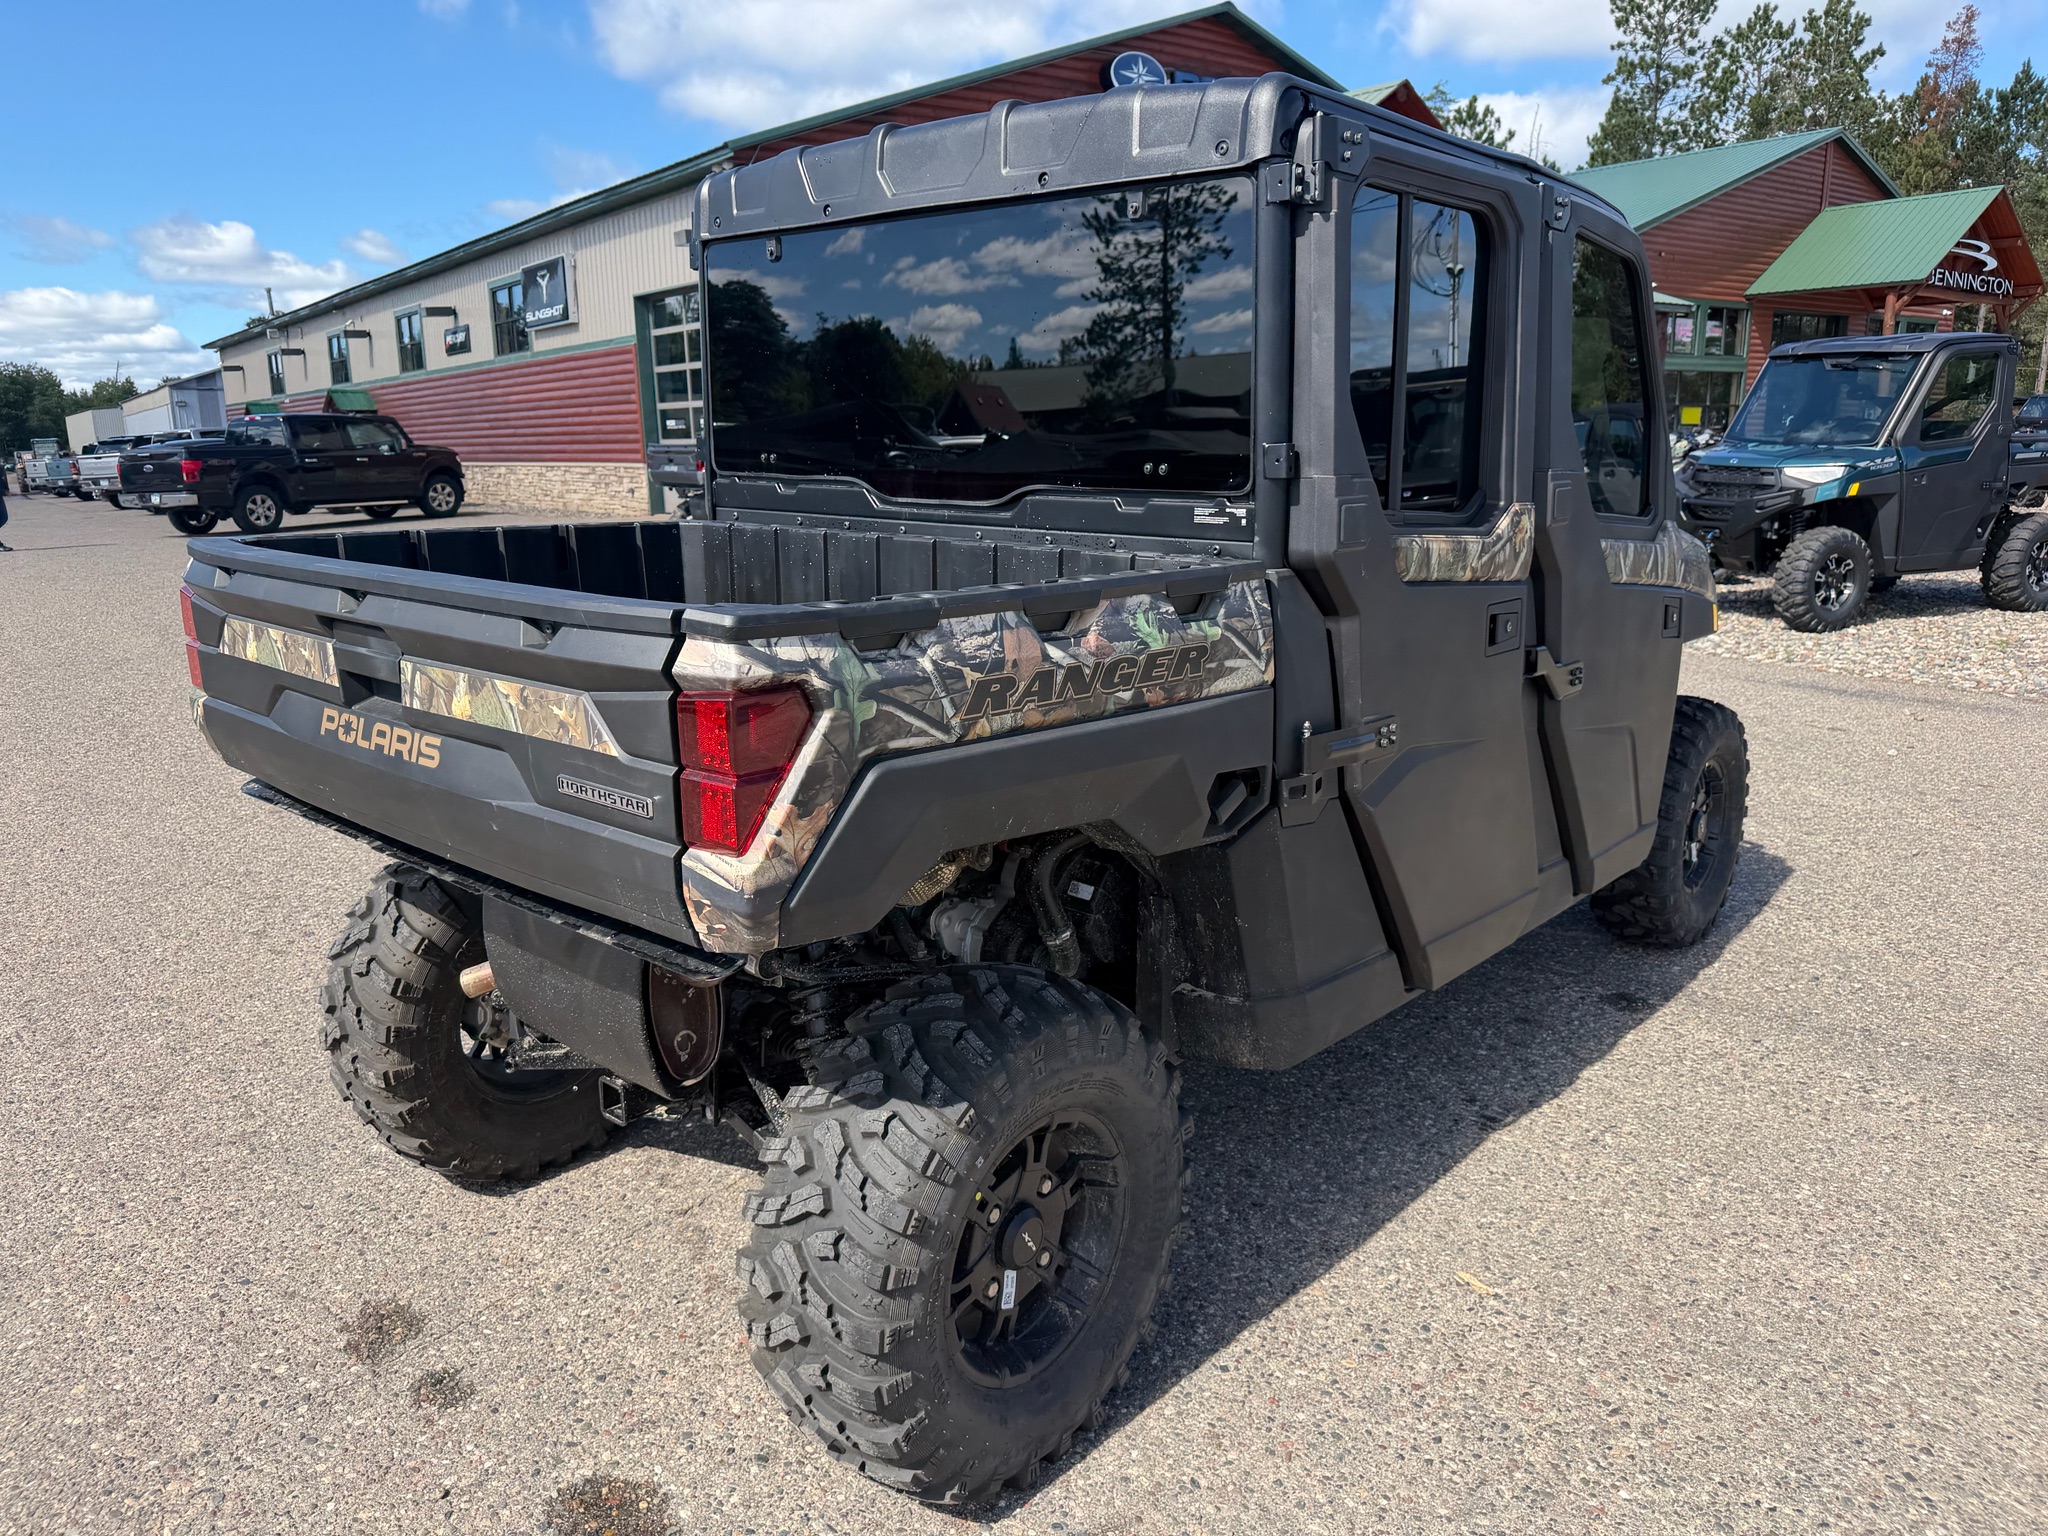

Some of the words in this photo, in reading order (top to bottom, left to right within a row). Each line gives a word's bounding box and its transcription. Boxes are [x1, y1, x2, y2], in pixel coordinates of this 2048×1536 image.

[525, 304, 564, 322] SLINGSHOT
[960, 642, 1210, 720] RANGER
[320, 707, 442, 769] POLARIS
[560, 779, 646, 814] NORTHSTAR
[1021, 1231, 1037, 1252] XP
